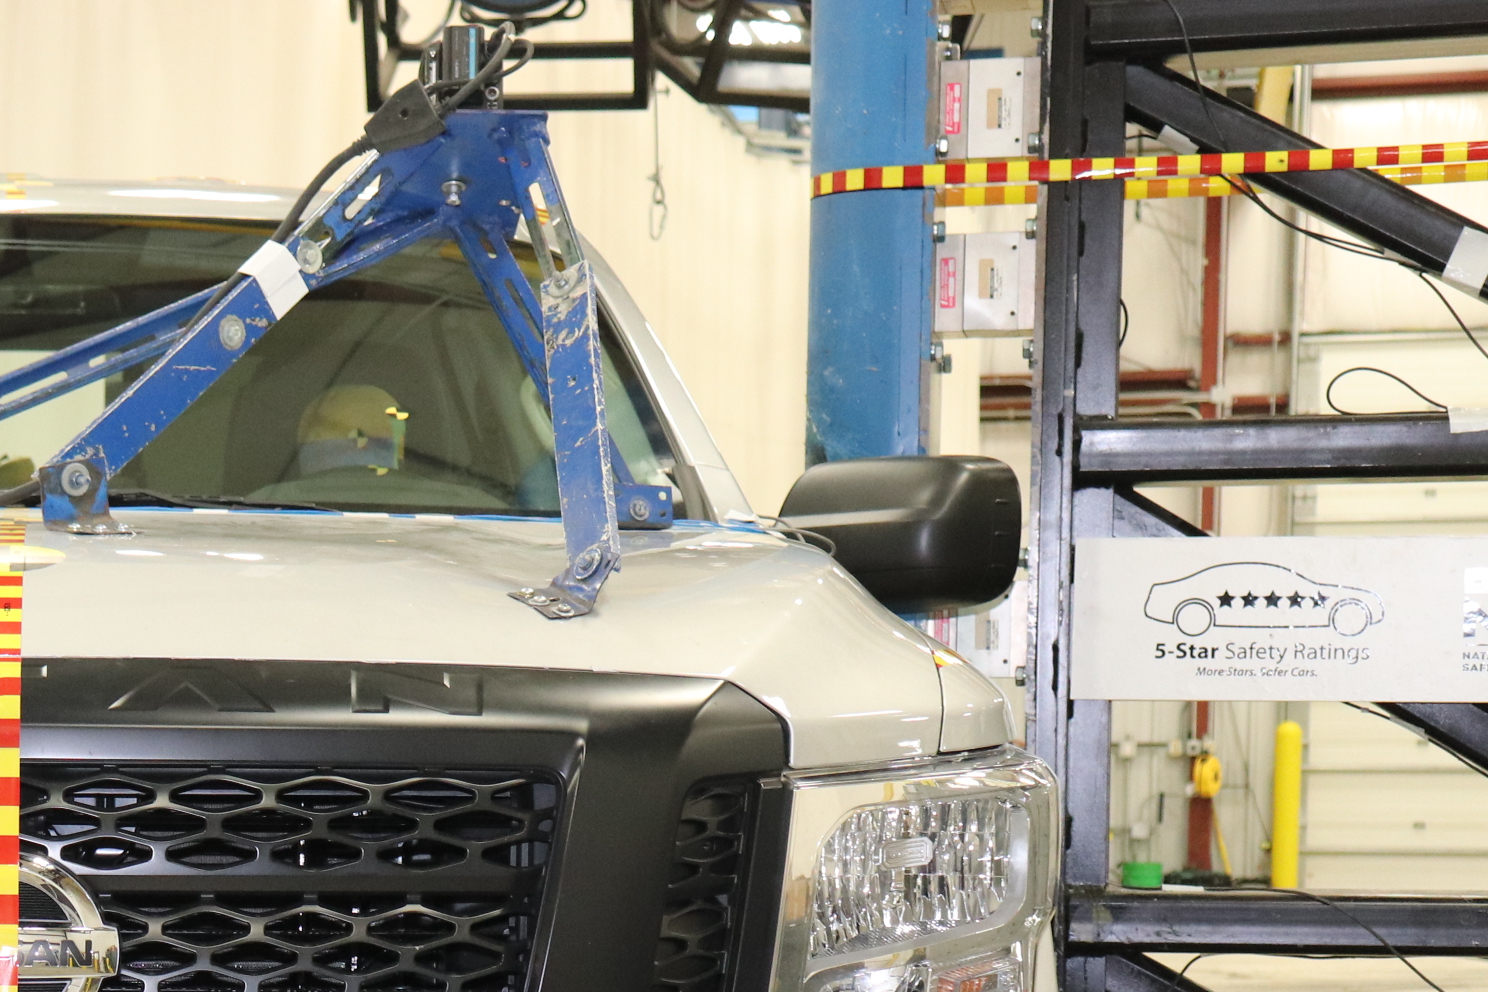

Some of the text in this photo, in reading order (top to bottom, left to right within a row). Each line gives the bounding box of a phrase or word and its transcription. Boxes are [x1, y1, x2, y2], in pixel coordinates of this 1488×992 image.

[1154, 642, 1370, 664] 5-Star Safety Ratings
[1195, 667, 1224, 677] More
[1226, 667, 1257, 677] Stars.
[1291, 667, 1318, 677] Cars.
